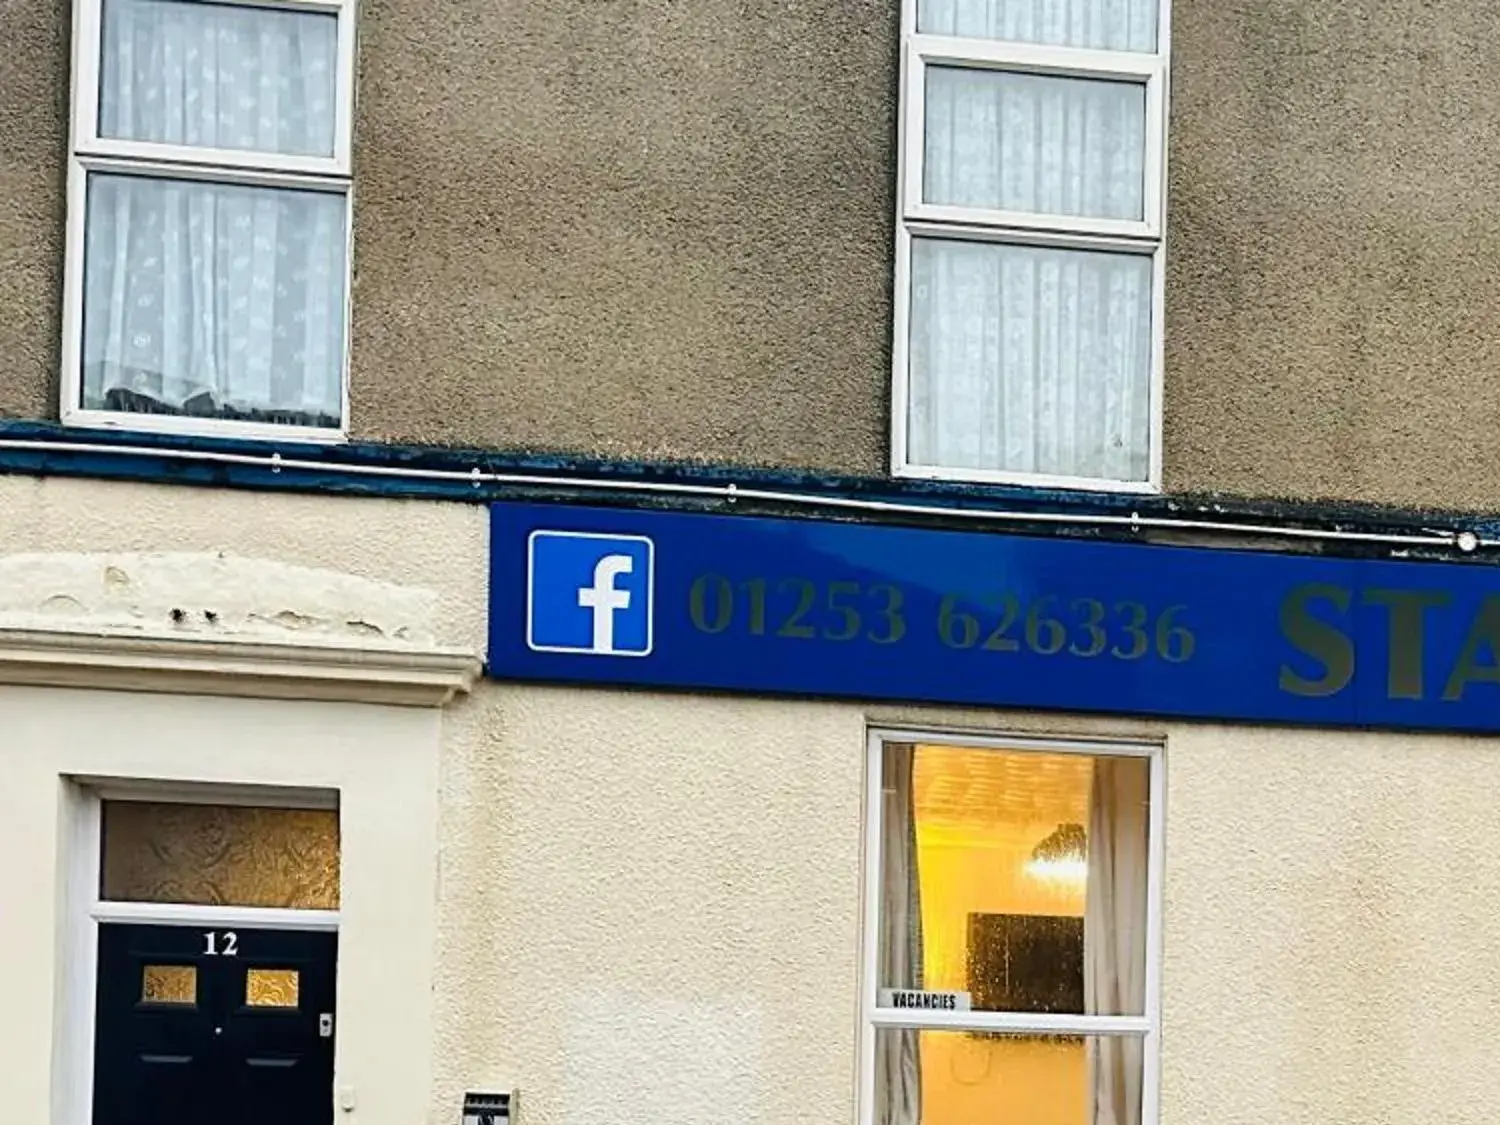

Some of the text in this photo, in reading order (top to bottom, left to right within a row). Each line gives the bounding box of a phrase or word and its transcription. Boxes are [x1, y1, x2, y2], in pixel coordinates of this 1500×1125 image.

[577, 554, 634, 655] f
[689, 573, 1196, 664] 01253 626336
[203, 931, 239, 956] 12
[892, 991, 956, 1010] VACANCIES
